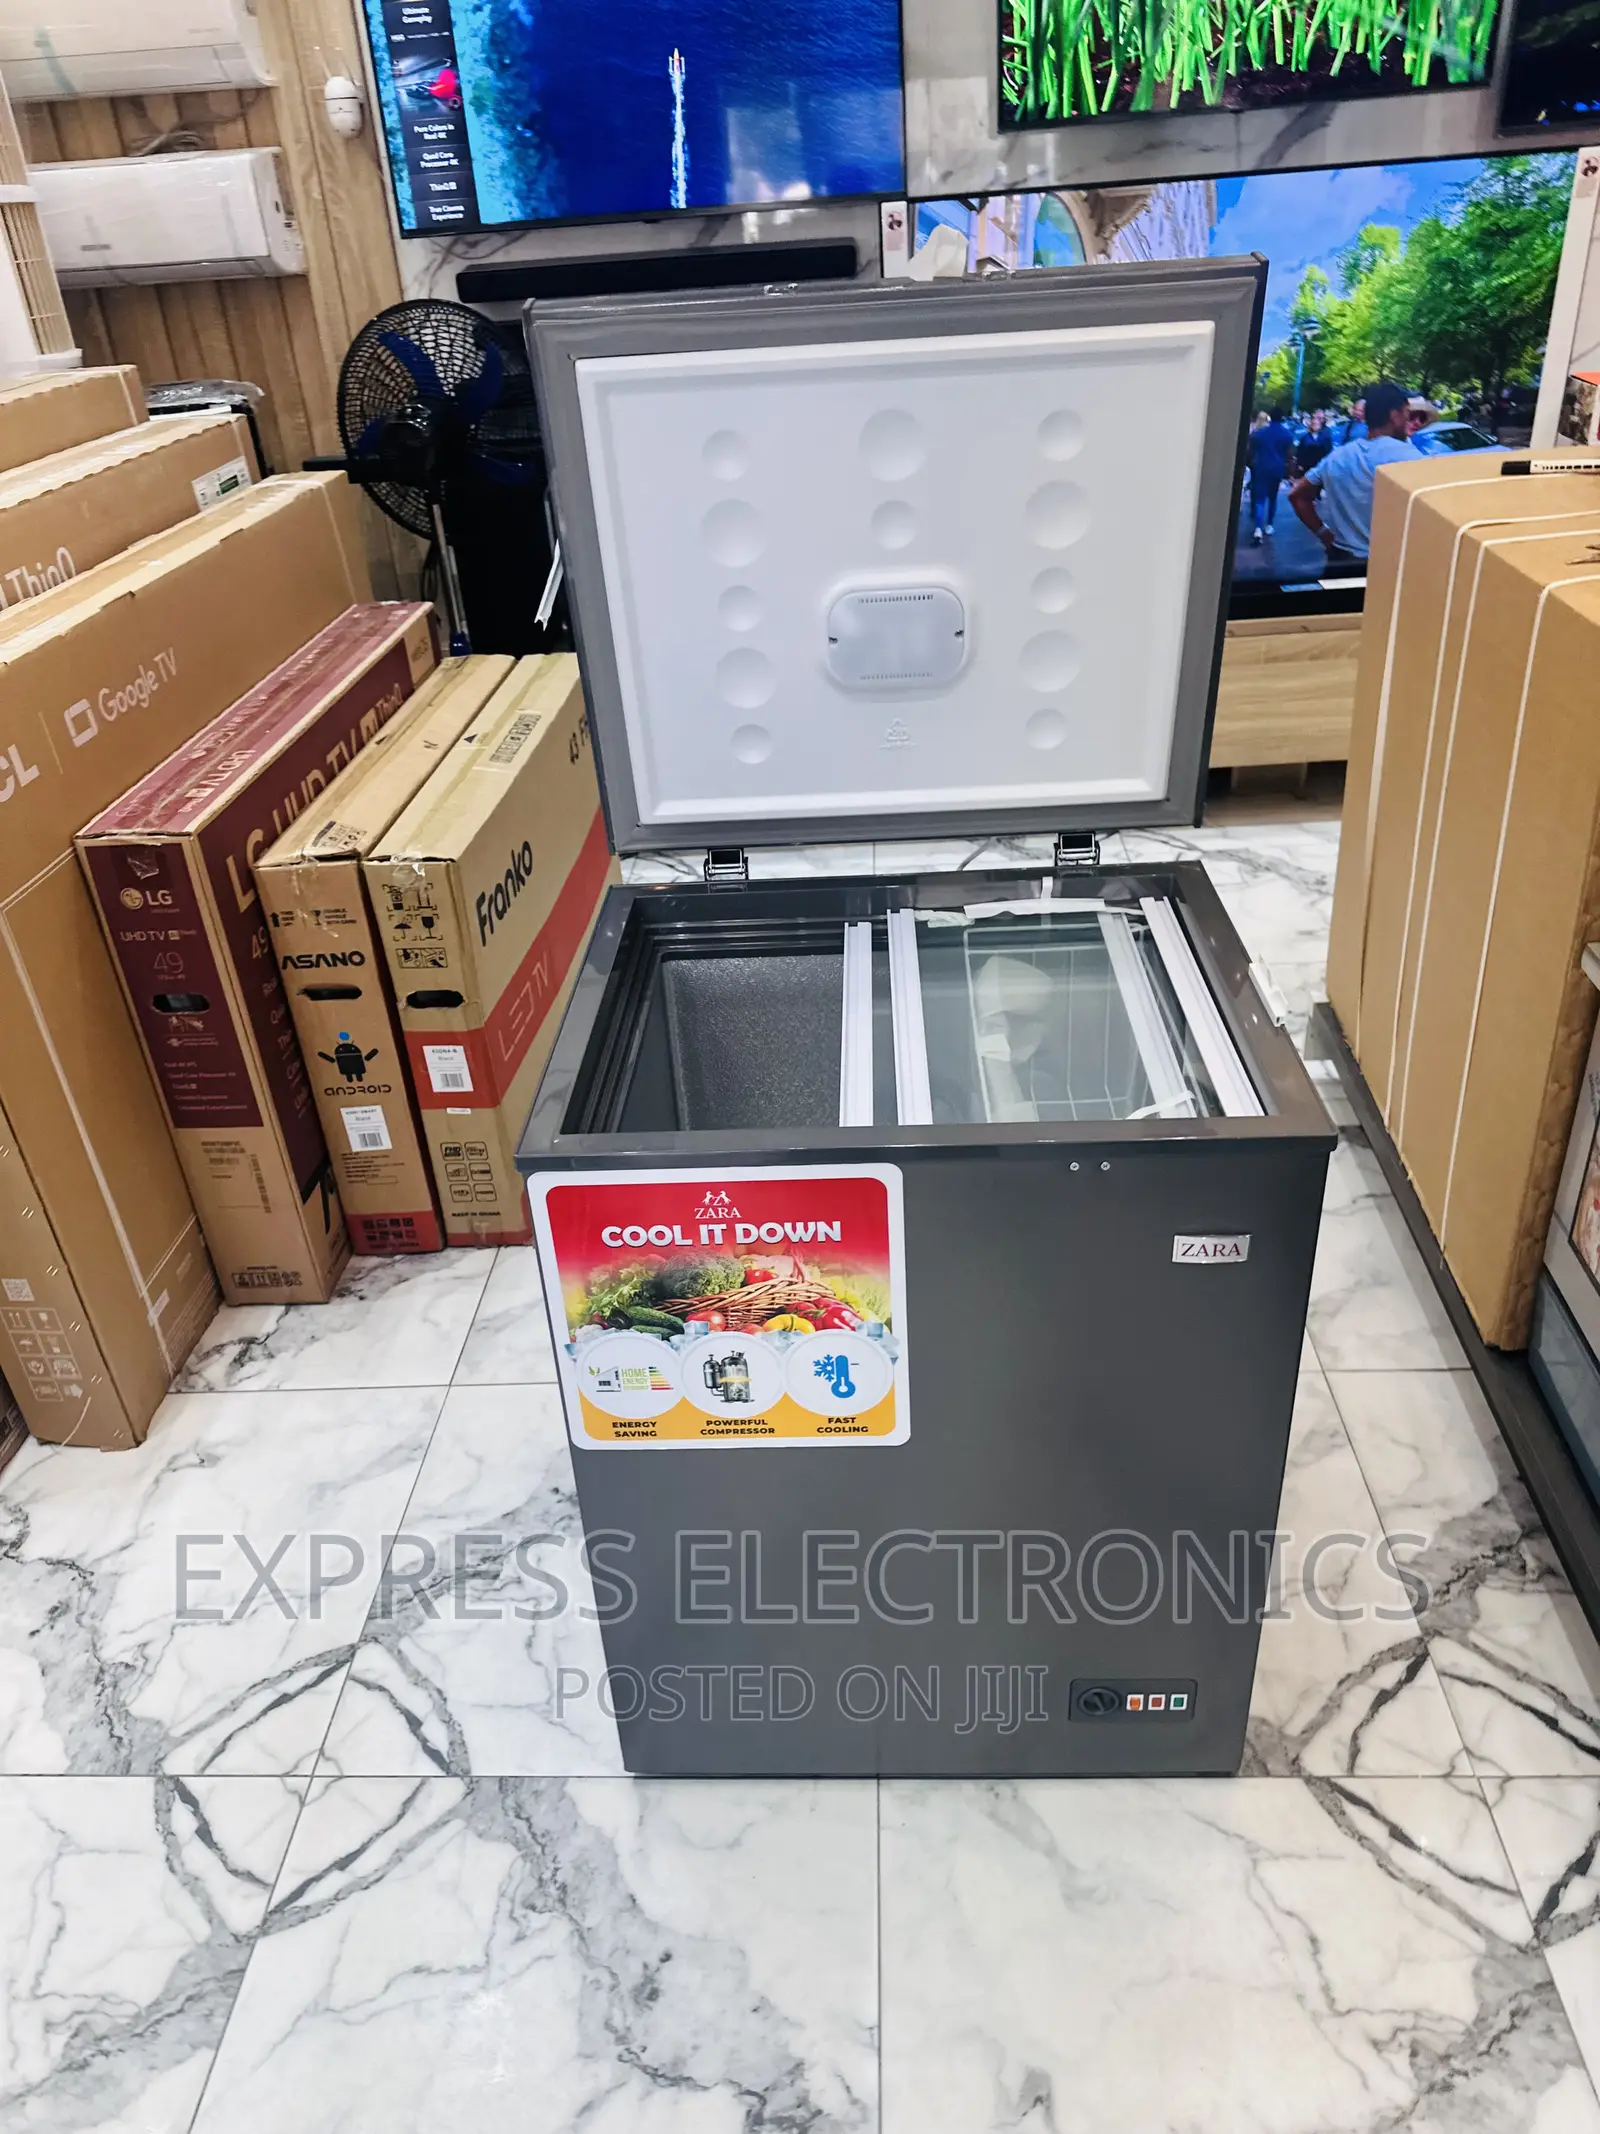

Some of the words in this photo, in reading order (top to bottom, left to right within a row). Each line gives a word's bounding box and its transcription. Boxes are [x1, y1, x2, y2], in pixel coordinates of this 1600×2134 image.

[98, 676, 159, 722] Google
[153, 647, 178, 683] TV
[145, 889, 173, 906] LG
[475, 840, 533, 947] Franko
[120, 931, 146, 941] UHD
[147, 931, 165, 941] TV
[153, 951, 184, 974] 49
[282, 950, 366, 970] ASANO
[695, 1207, 742, 1220] ZARA
[601, 1225, 693, 1248] COOL
[700, 1223, 727, 1245] IT
[735, 1221, 842, 1244] DOWN
[1181, 1243, 1242, 1257] ZARA
[621, 1368, 648, 1378] HOME
[612, 1421, 657, 1429] ENERGY
[706, 1419, 768, 1427] POWERFUL
[828, 1416, 857, 1424] FAST
[614, 1430, 658, 1438] SAVING
[700, 1427, 775, 1436] COMPRESSOR
[817, 1425, 869, 1434] COOLING
